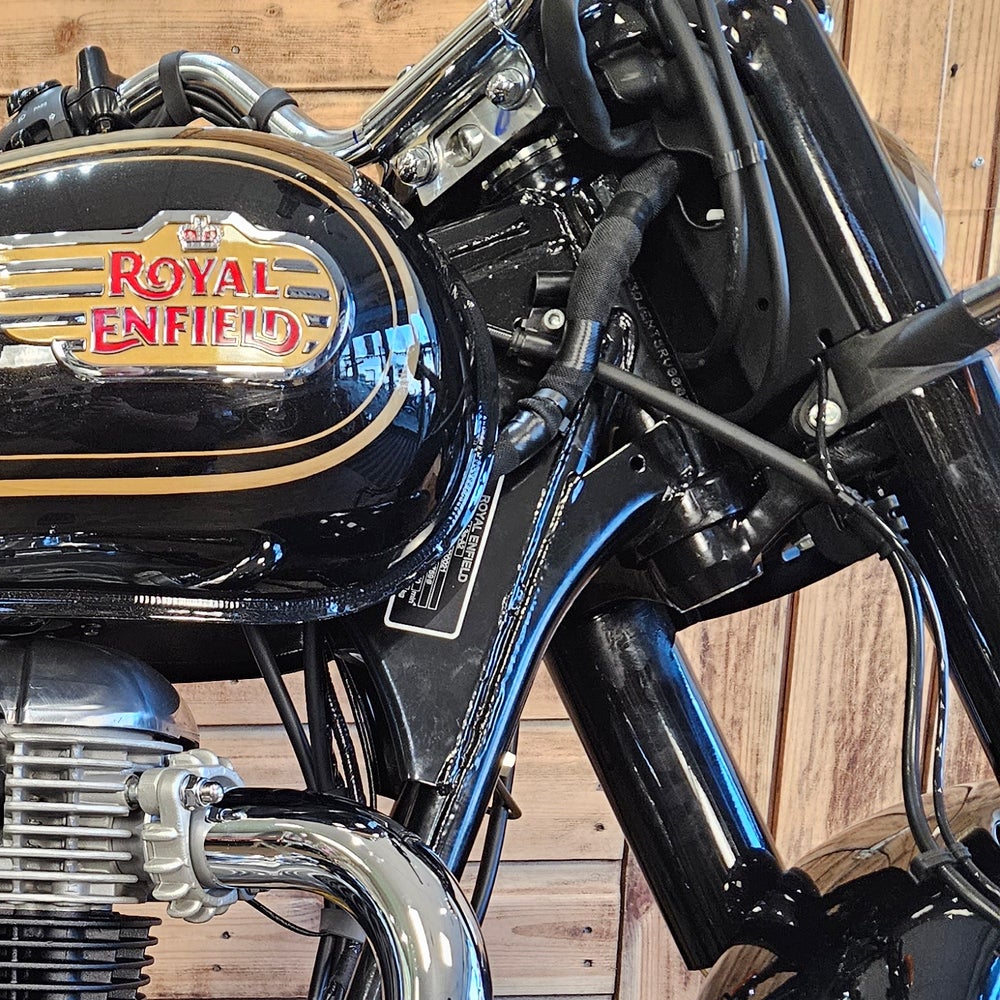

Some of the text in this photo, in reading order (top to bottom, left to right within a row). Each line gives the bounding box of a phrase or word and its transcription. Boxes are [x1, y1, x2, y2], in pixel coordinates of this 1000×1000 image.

[108, 250, 280, 301] ROYAL
[90, 306, 303, 356] ENFIELD
[457, 495, 491, 583] ROYAL ENFIELD
